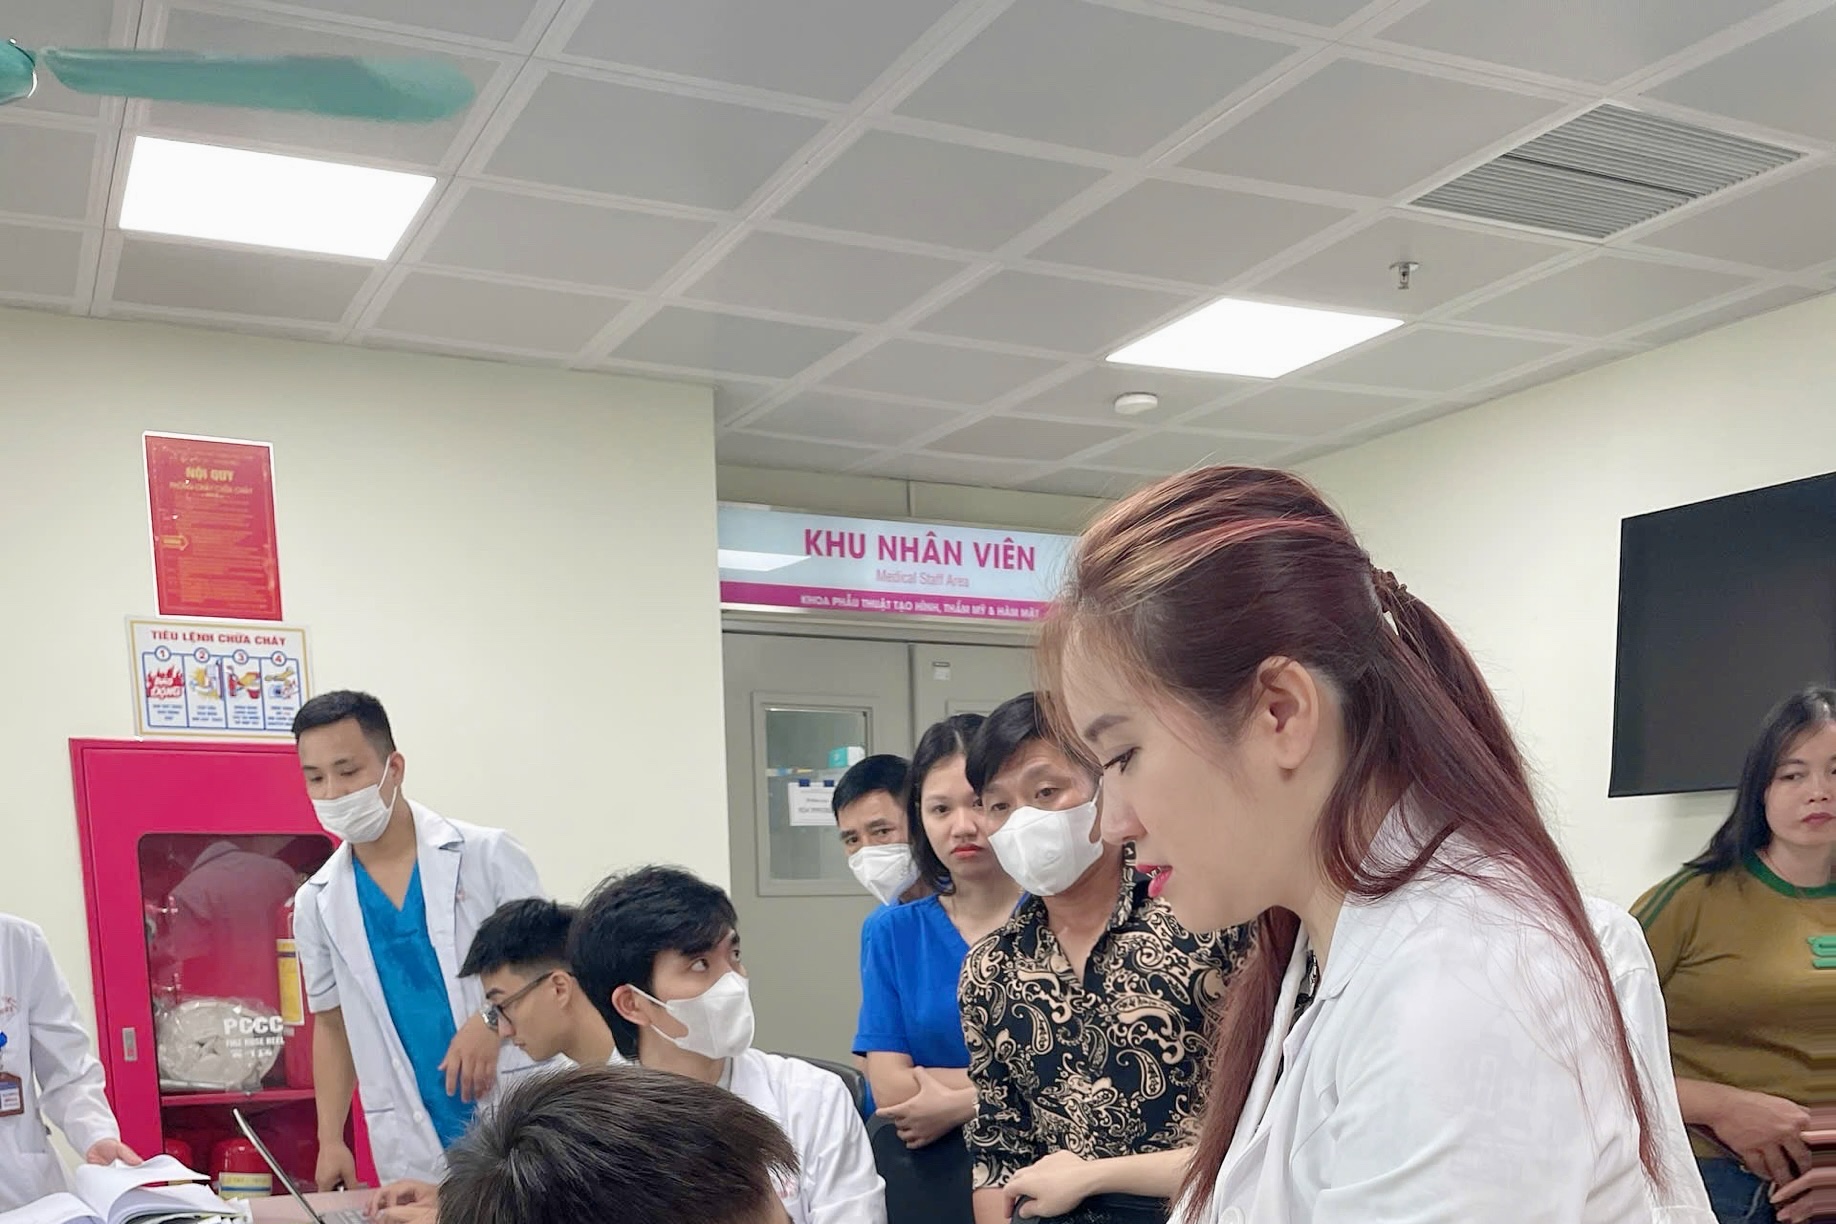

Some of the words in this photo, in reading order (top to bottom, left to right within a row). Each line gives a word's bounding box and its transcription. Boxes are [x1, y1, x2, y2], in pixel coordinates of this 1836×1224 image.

[804, 528, 866, 560] KHU
[878, 530, 962, 566] NHÂN
[973, 537, 1035, 571] VIÊN
[876, 568, 917, 584] Medical
[920, 572, 944, 586] Staff
[946, 573, 969, 588] Area
[800, 595, 830, 606] KHOA
[223, 1016, 284, 1035] PCCC
